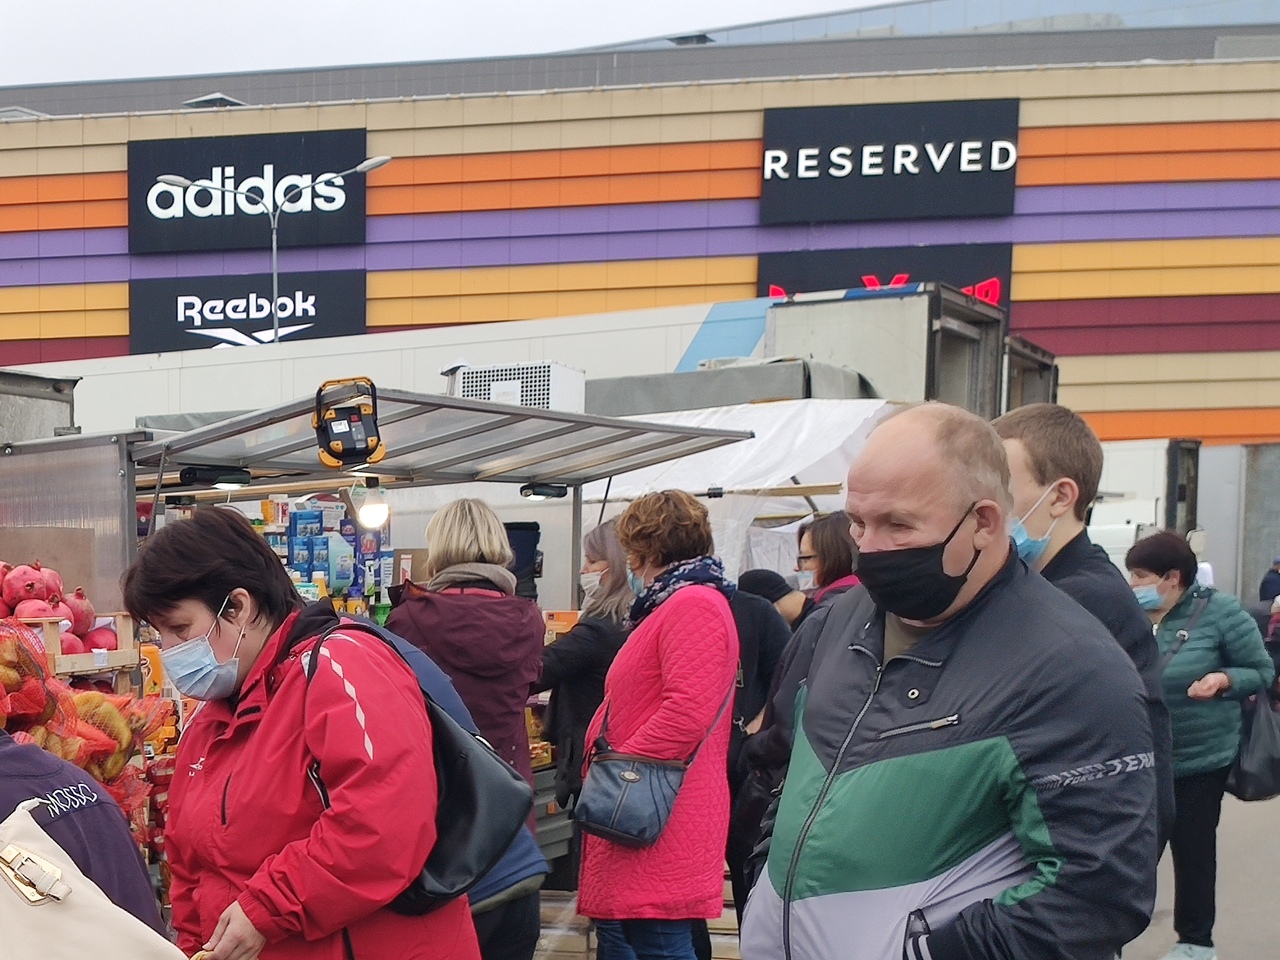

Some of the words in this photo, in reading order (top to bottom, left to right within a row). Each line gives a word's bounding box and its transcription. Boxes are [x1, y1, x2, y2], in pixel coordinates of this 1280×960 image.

[763, 140, 1017, 180] RESERVED
[146, 164, 346, 219] adidas
[177, 291, 316, 326] Reebok
